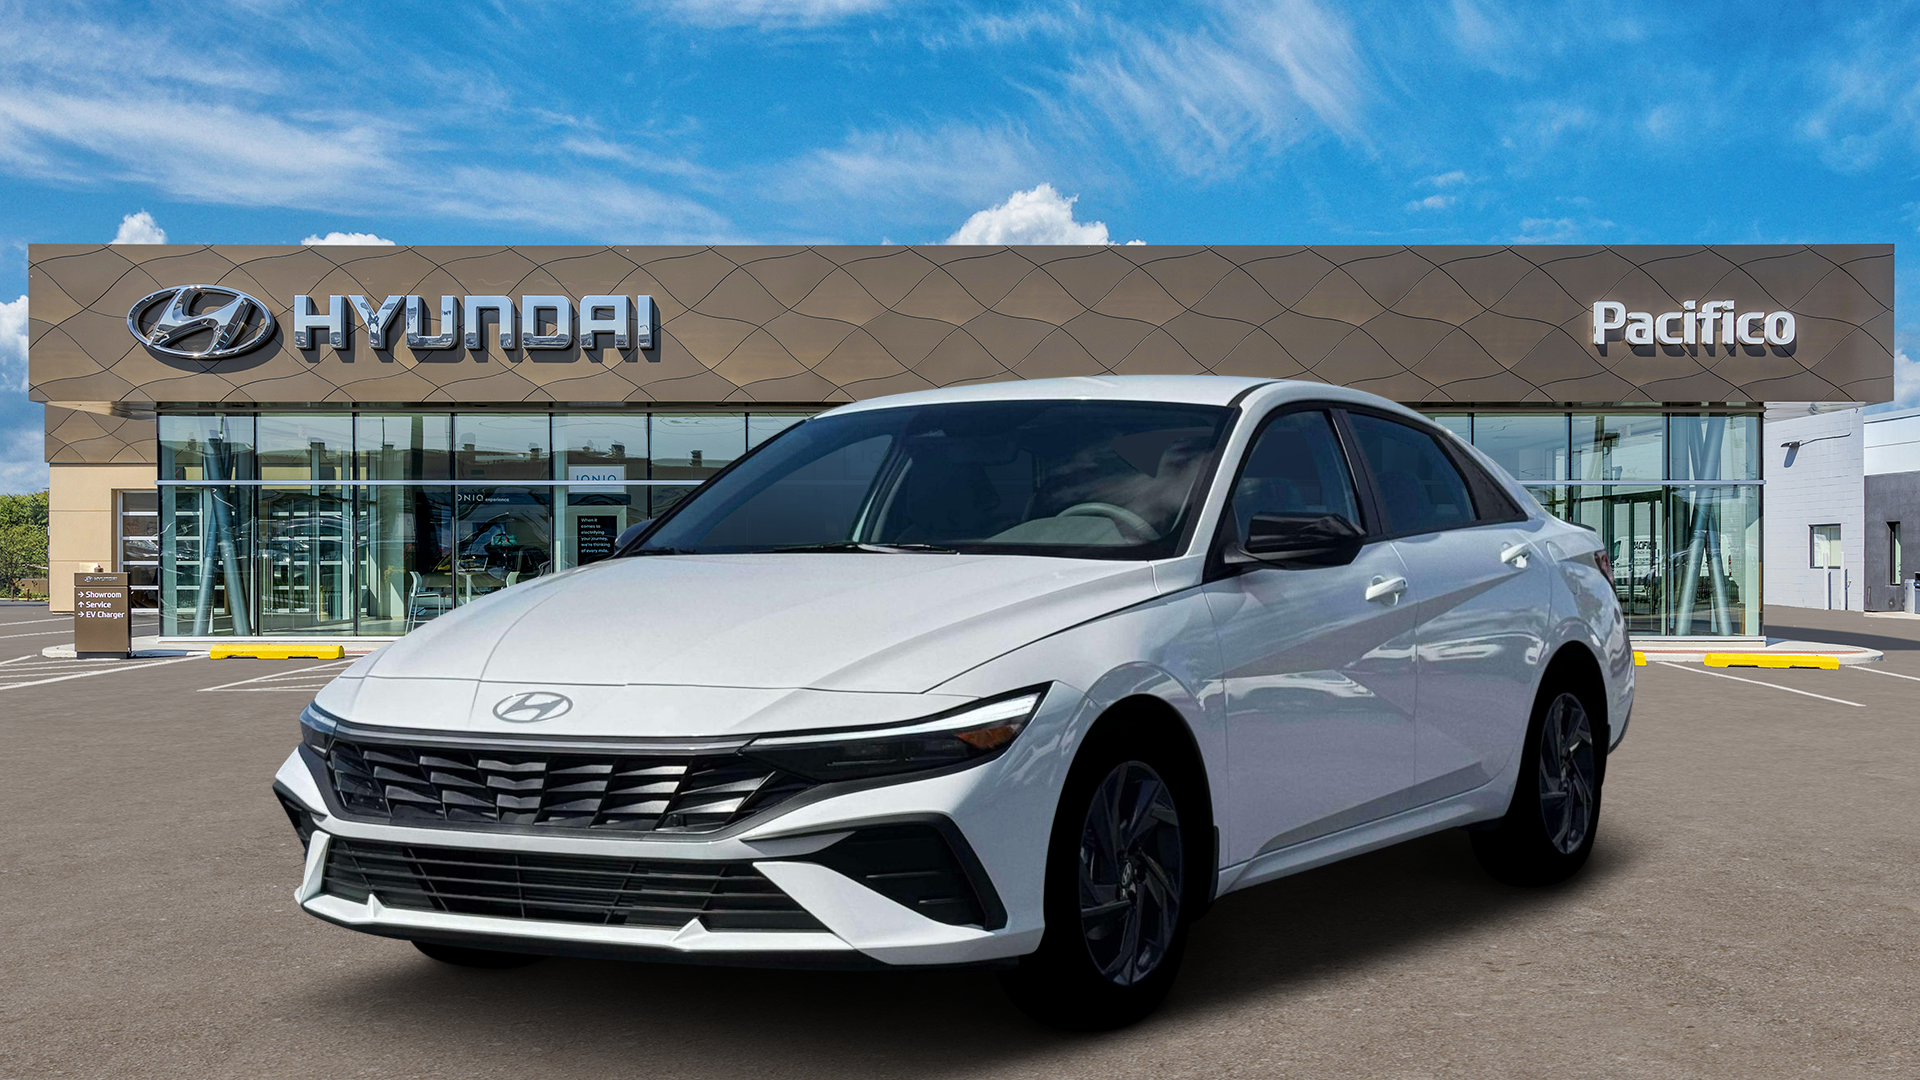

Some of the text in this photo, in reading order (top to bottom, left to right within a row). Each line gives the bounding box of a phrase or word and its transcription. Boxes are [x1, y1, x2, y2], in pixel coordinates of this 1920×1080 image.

[293, 295, 654, 350] HYUNDAI
[1593, 299, 1797, 346] Pacifico
[457, 494, 484, 502] ONIQ
[85, 590, 122, 598] Showroom
[85, 601, 112, 609] Service
[97, 611, 125, 620] Charger
